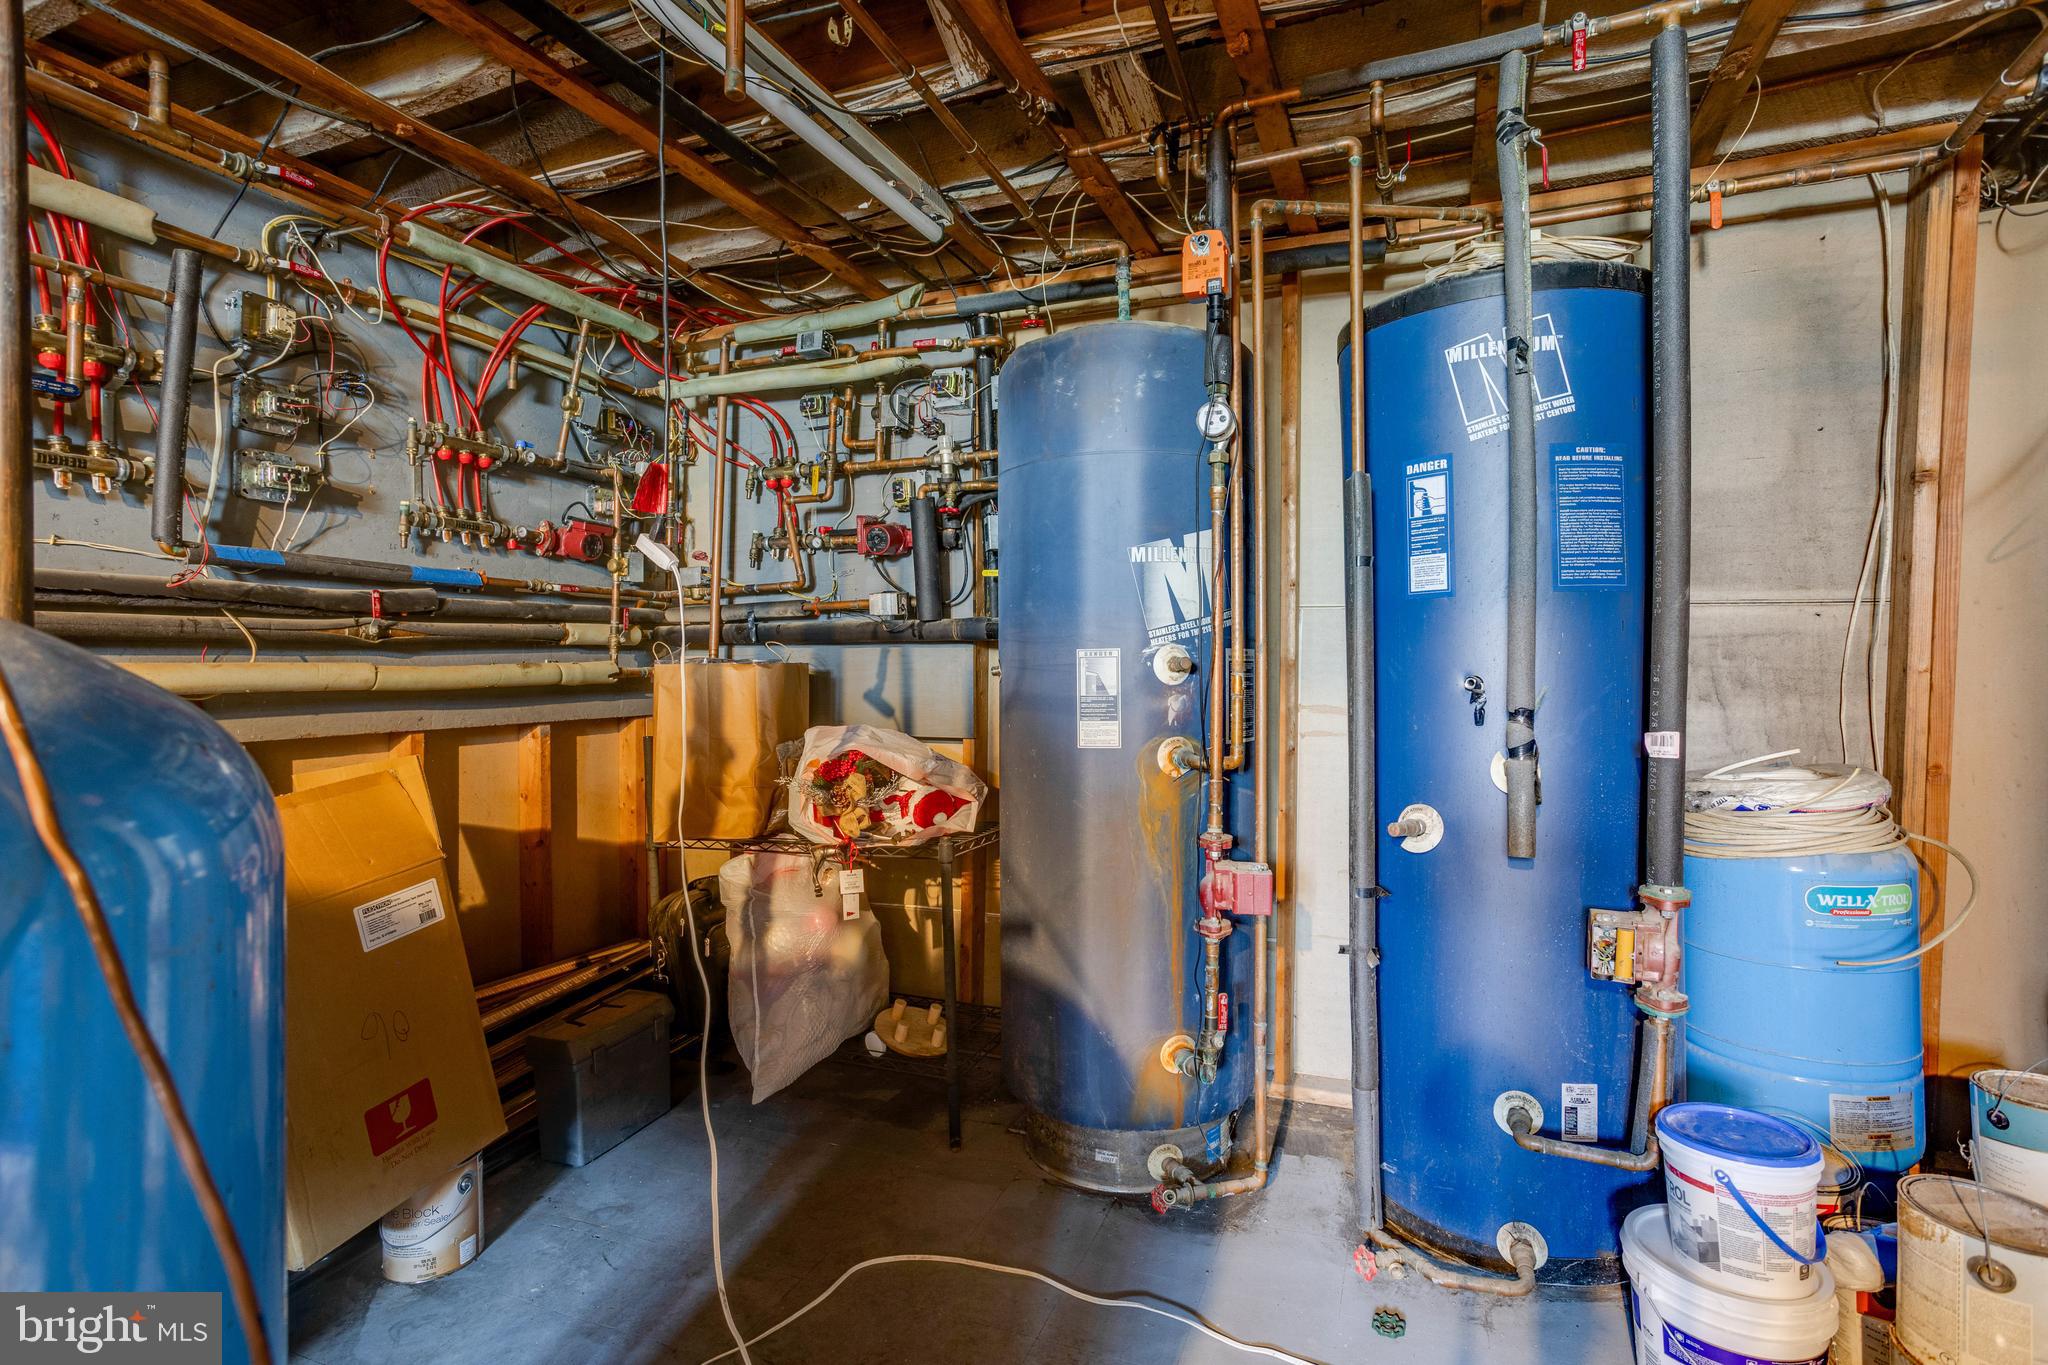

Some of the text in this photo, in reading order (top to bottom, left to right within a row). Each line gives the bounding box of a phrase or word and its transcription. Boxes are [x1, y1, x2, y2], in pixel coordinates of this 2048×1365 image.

[1449, 335, 1555, 364] MILLENUM
[1552, 396, 1575, 409] WATER
[1547, 404, 1576, 419] CENTURY
[1466, 416, 1501, 434] STAINLESS
[1406, 459, 1448, 475] DANGER
[1148, 624, 1180, 638] STAINLESS
[1180, 620, 1197, 631] STEEL
[1178, 629, 1190, 640] FOR
[402, 1205, 440, 1220] Block
